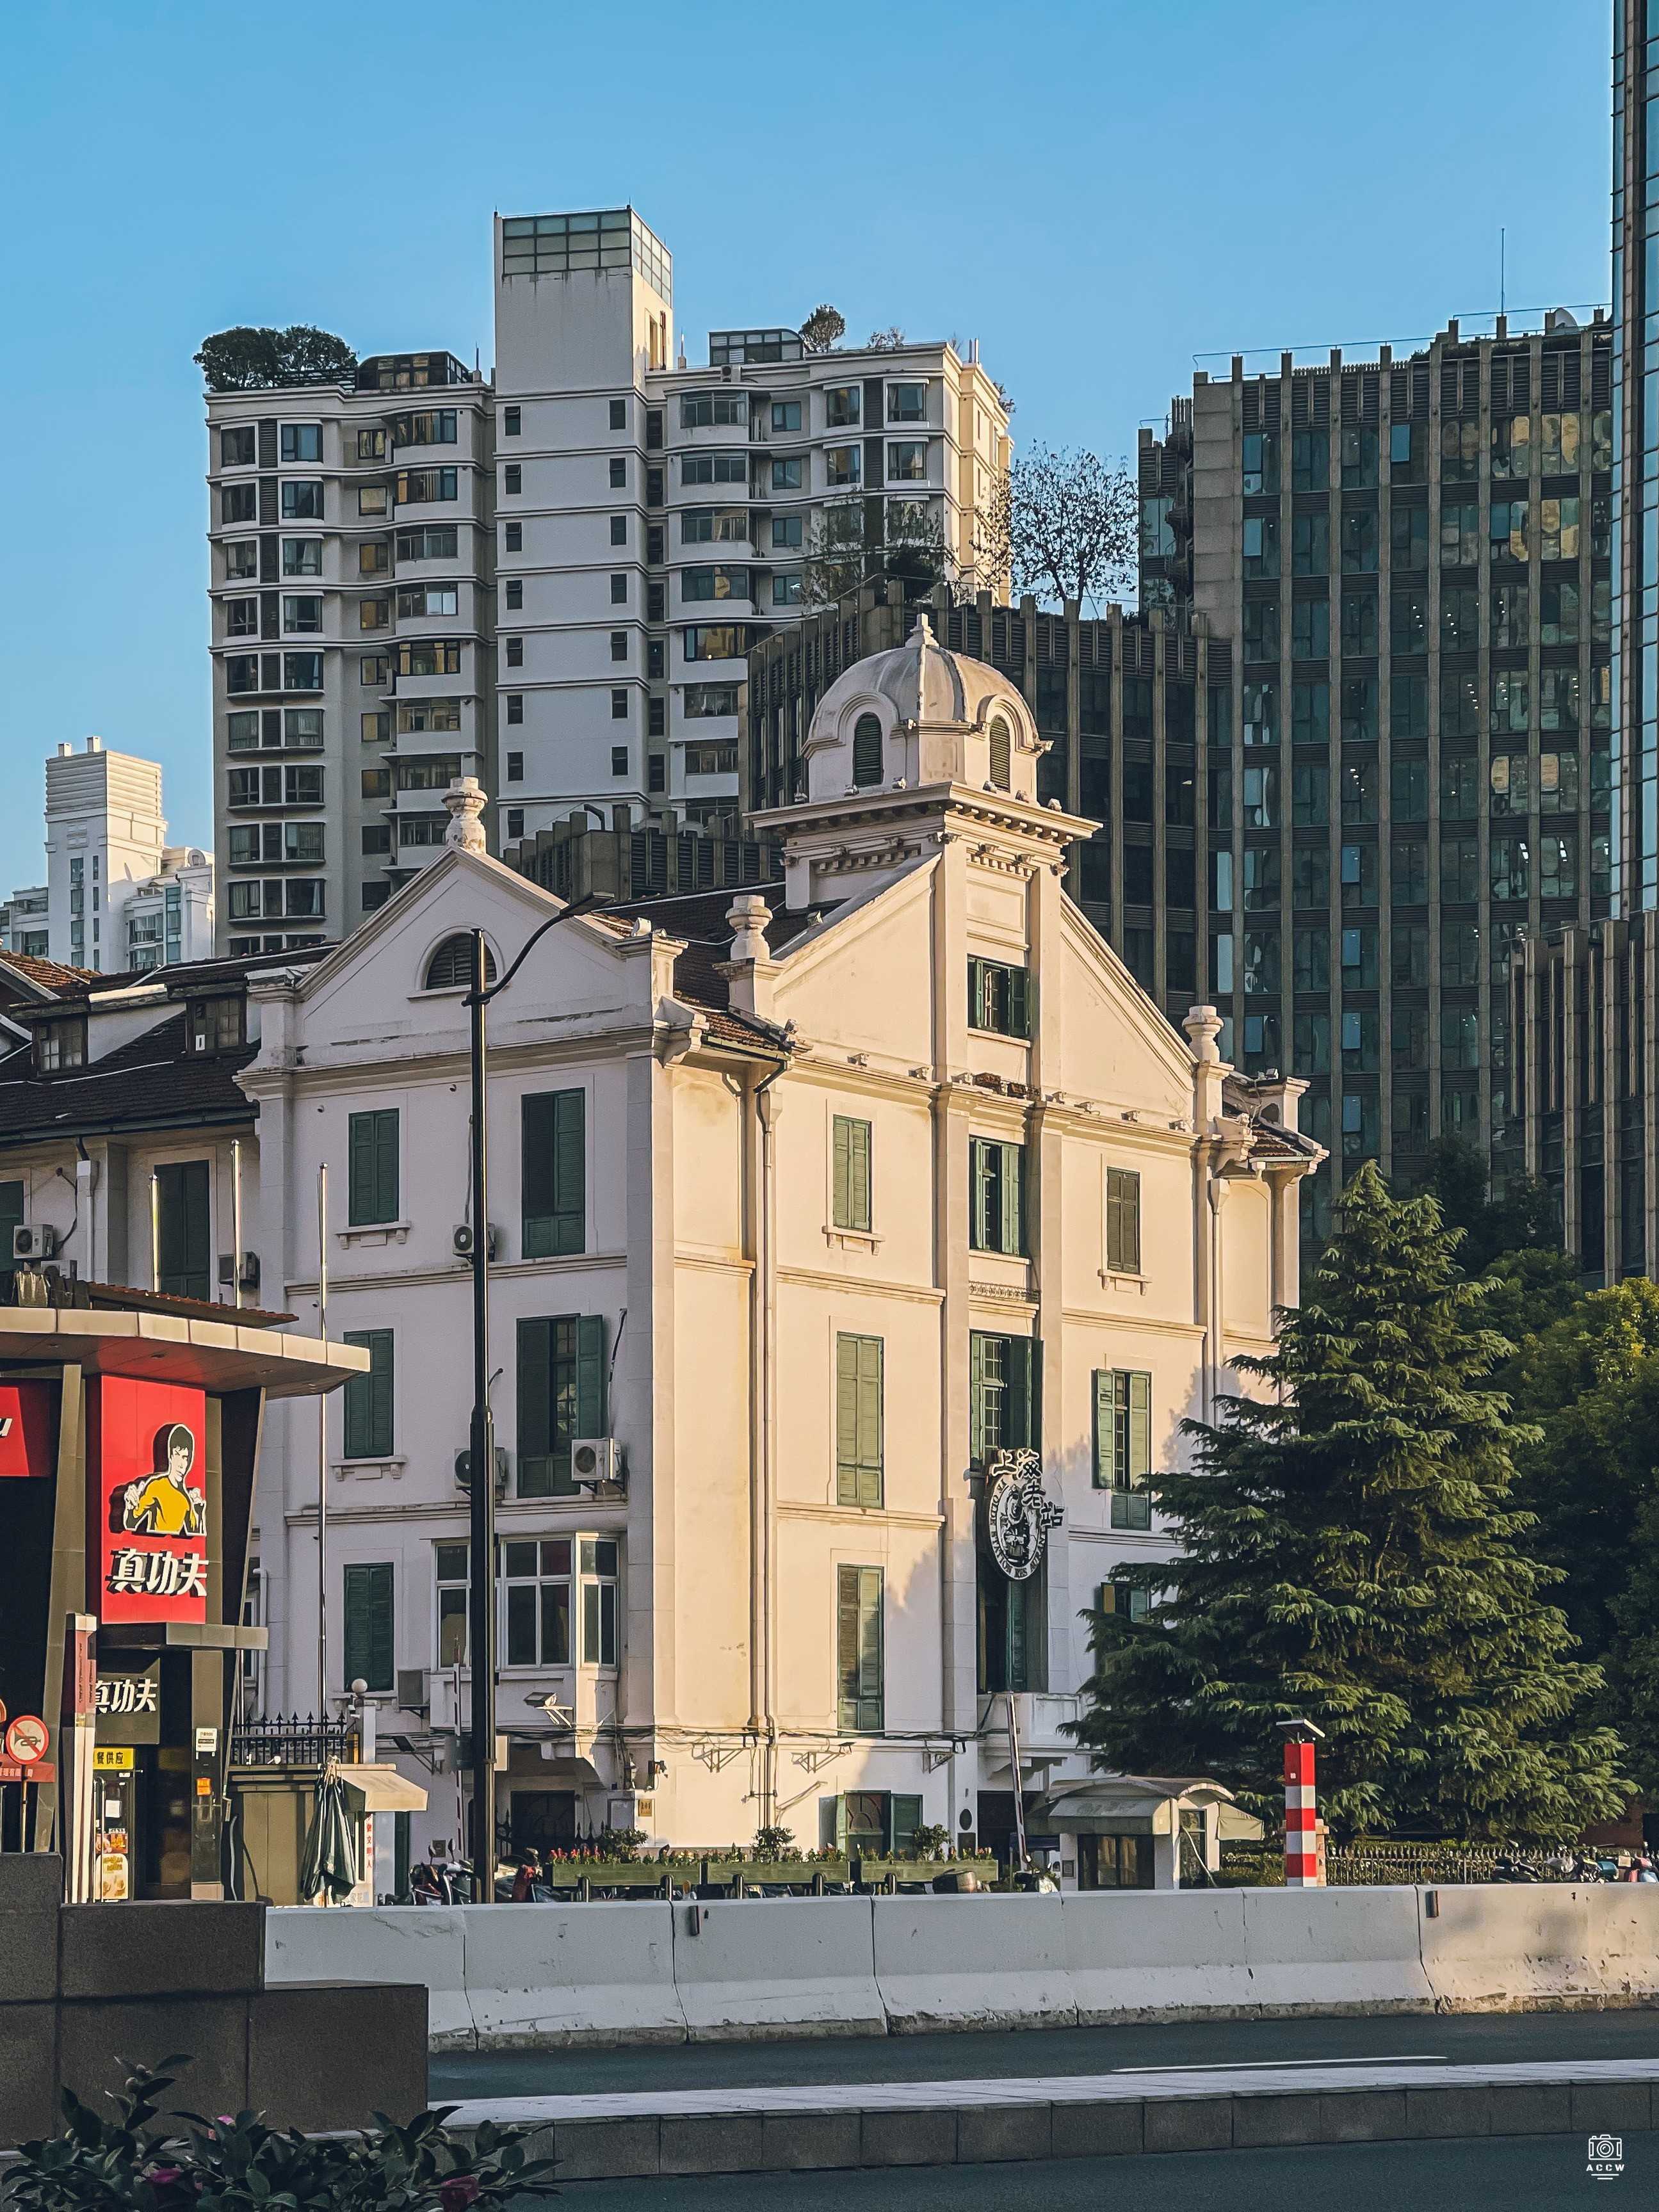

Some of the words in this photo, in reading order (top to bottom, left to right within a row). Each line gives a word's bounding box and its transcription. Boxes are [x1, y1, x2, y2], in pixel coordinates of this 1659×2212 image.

[112, 1547, 209, 1597] 真功夫
[95, 1678, 158, 1714] 真功夫
[93, 1751, 124, 1764] 餐供应
